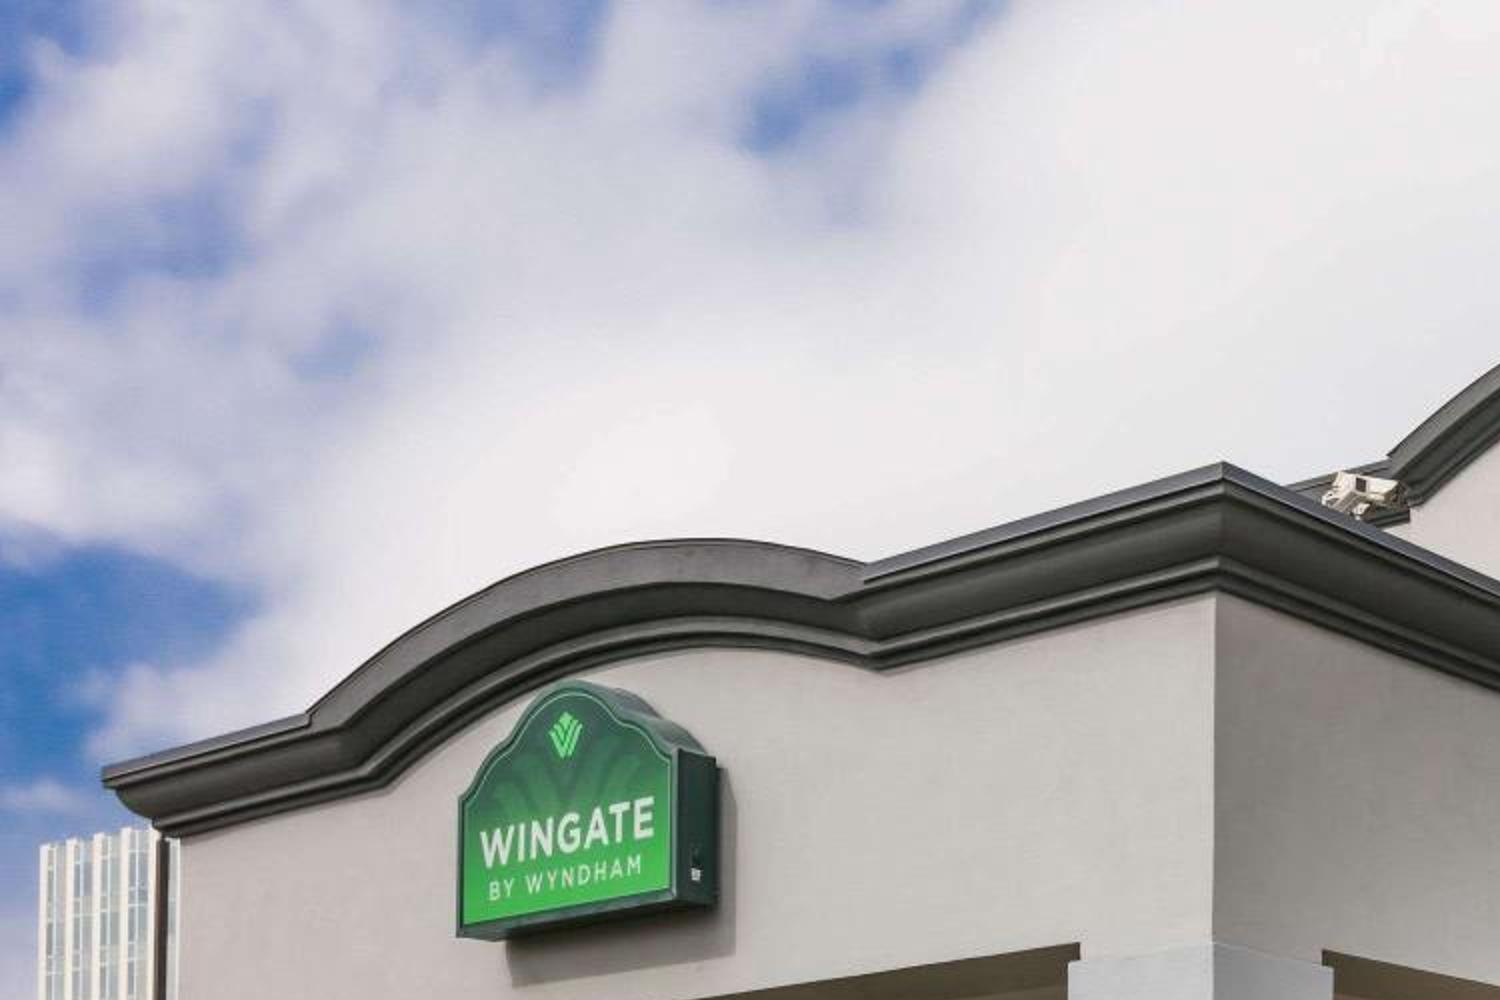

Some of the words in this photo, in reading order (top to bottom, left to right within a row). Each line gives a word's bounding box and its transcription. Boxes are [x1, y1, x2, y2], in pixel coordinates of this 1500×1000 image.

[479, 796, 655, 869] WINGATE
[489, 878, 515, 902] BY
[526, 854, 642, 894] WYNDHAM
